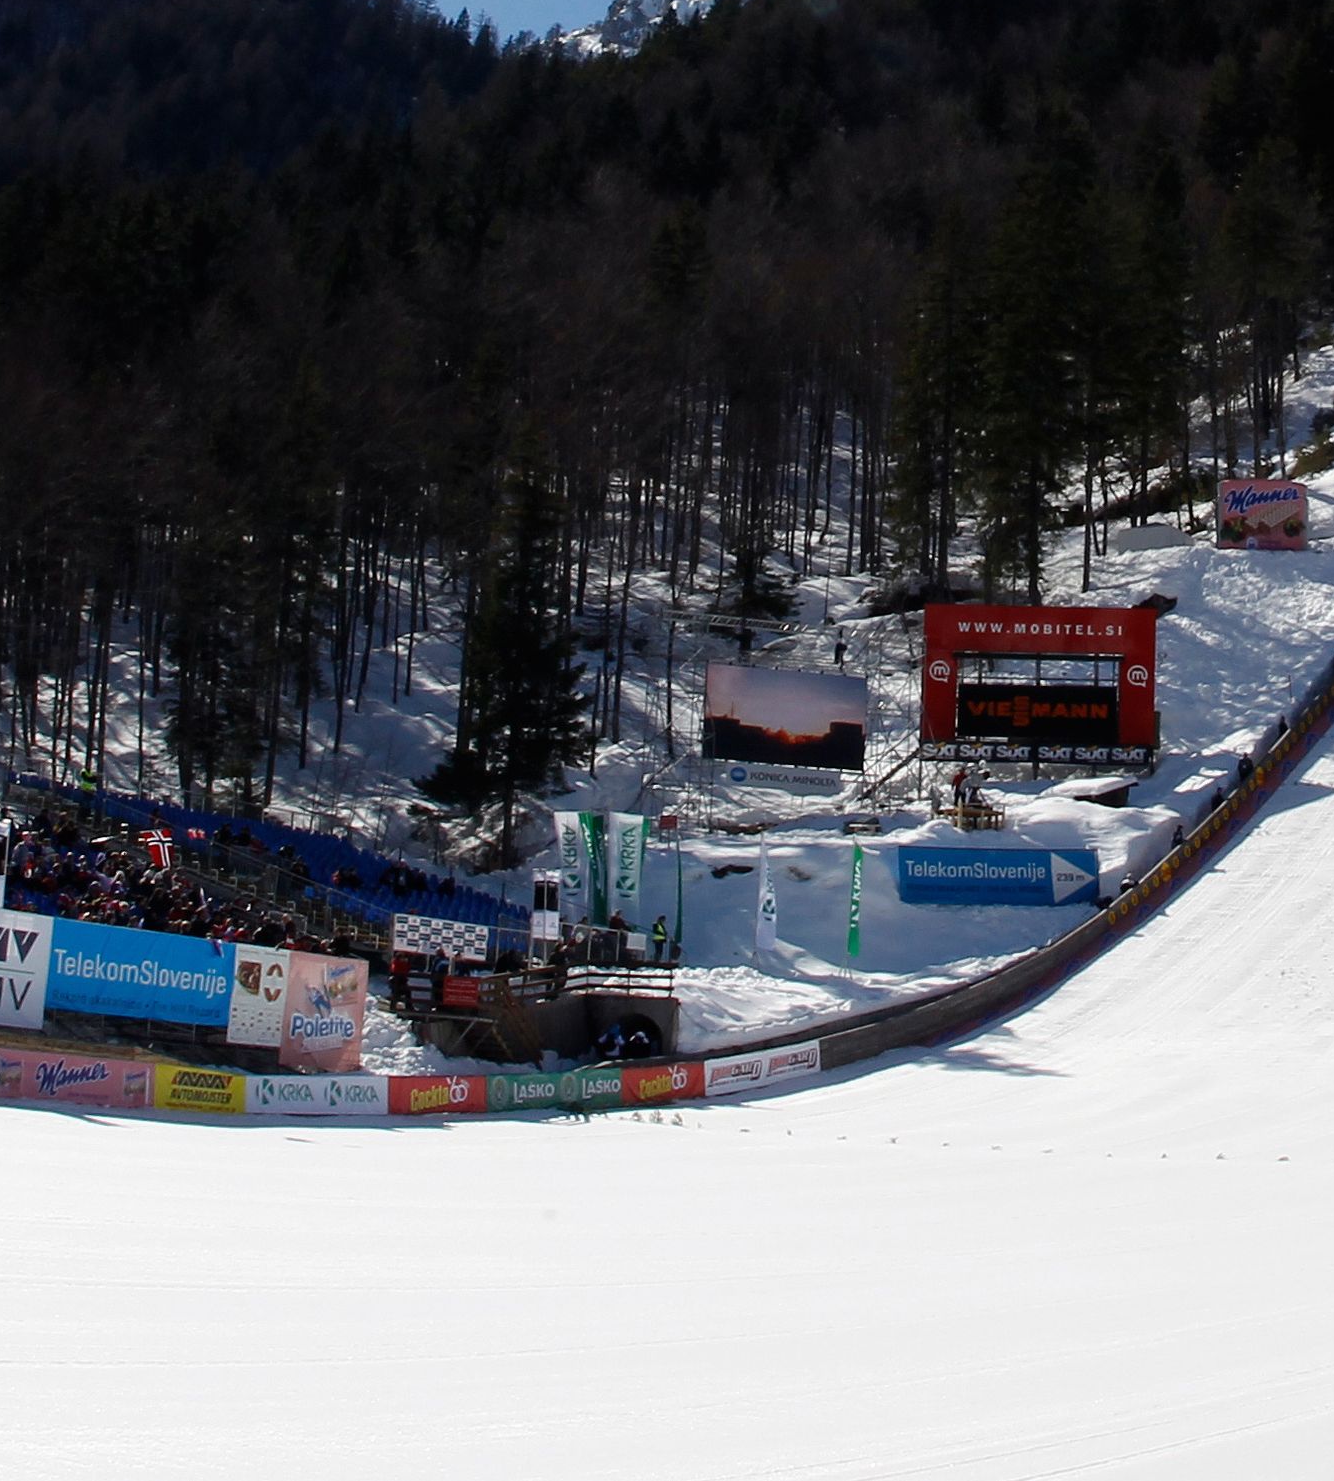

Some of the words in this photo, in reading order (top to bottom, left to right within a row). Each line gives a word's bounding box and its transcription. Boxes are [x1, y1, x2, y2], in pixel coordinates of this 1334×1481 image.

[1223, 485, 1300, 515] Manner
[958, 621, 1124, 637] WWW.MOBITEL.SI
[620, 825, 637, 870] KRKA
[36, 1059, 109, 1096] Manner
[278, 1083, 314, 1103] KRKA
[344, 1085, 380, 1103] KRKA
